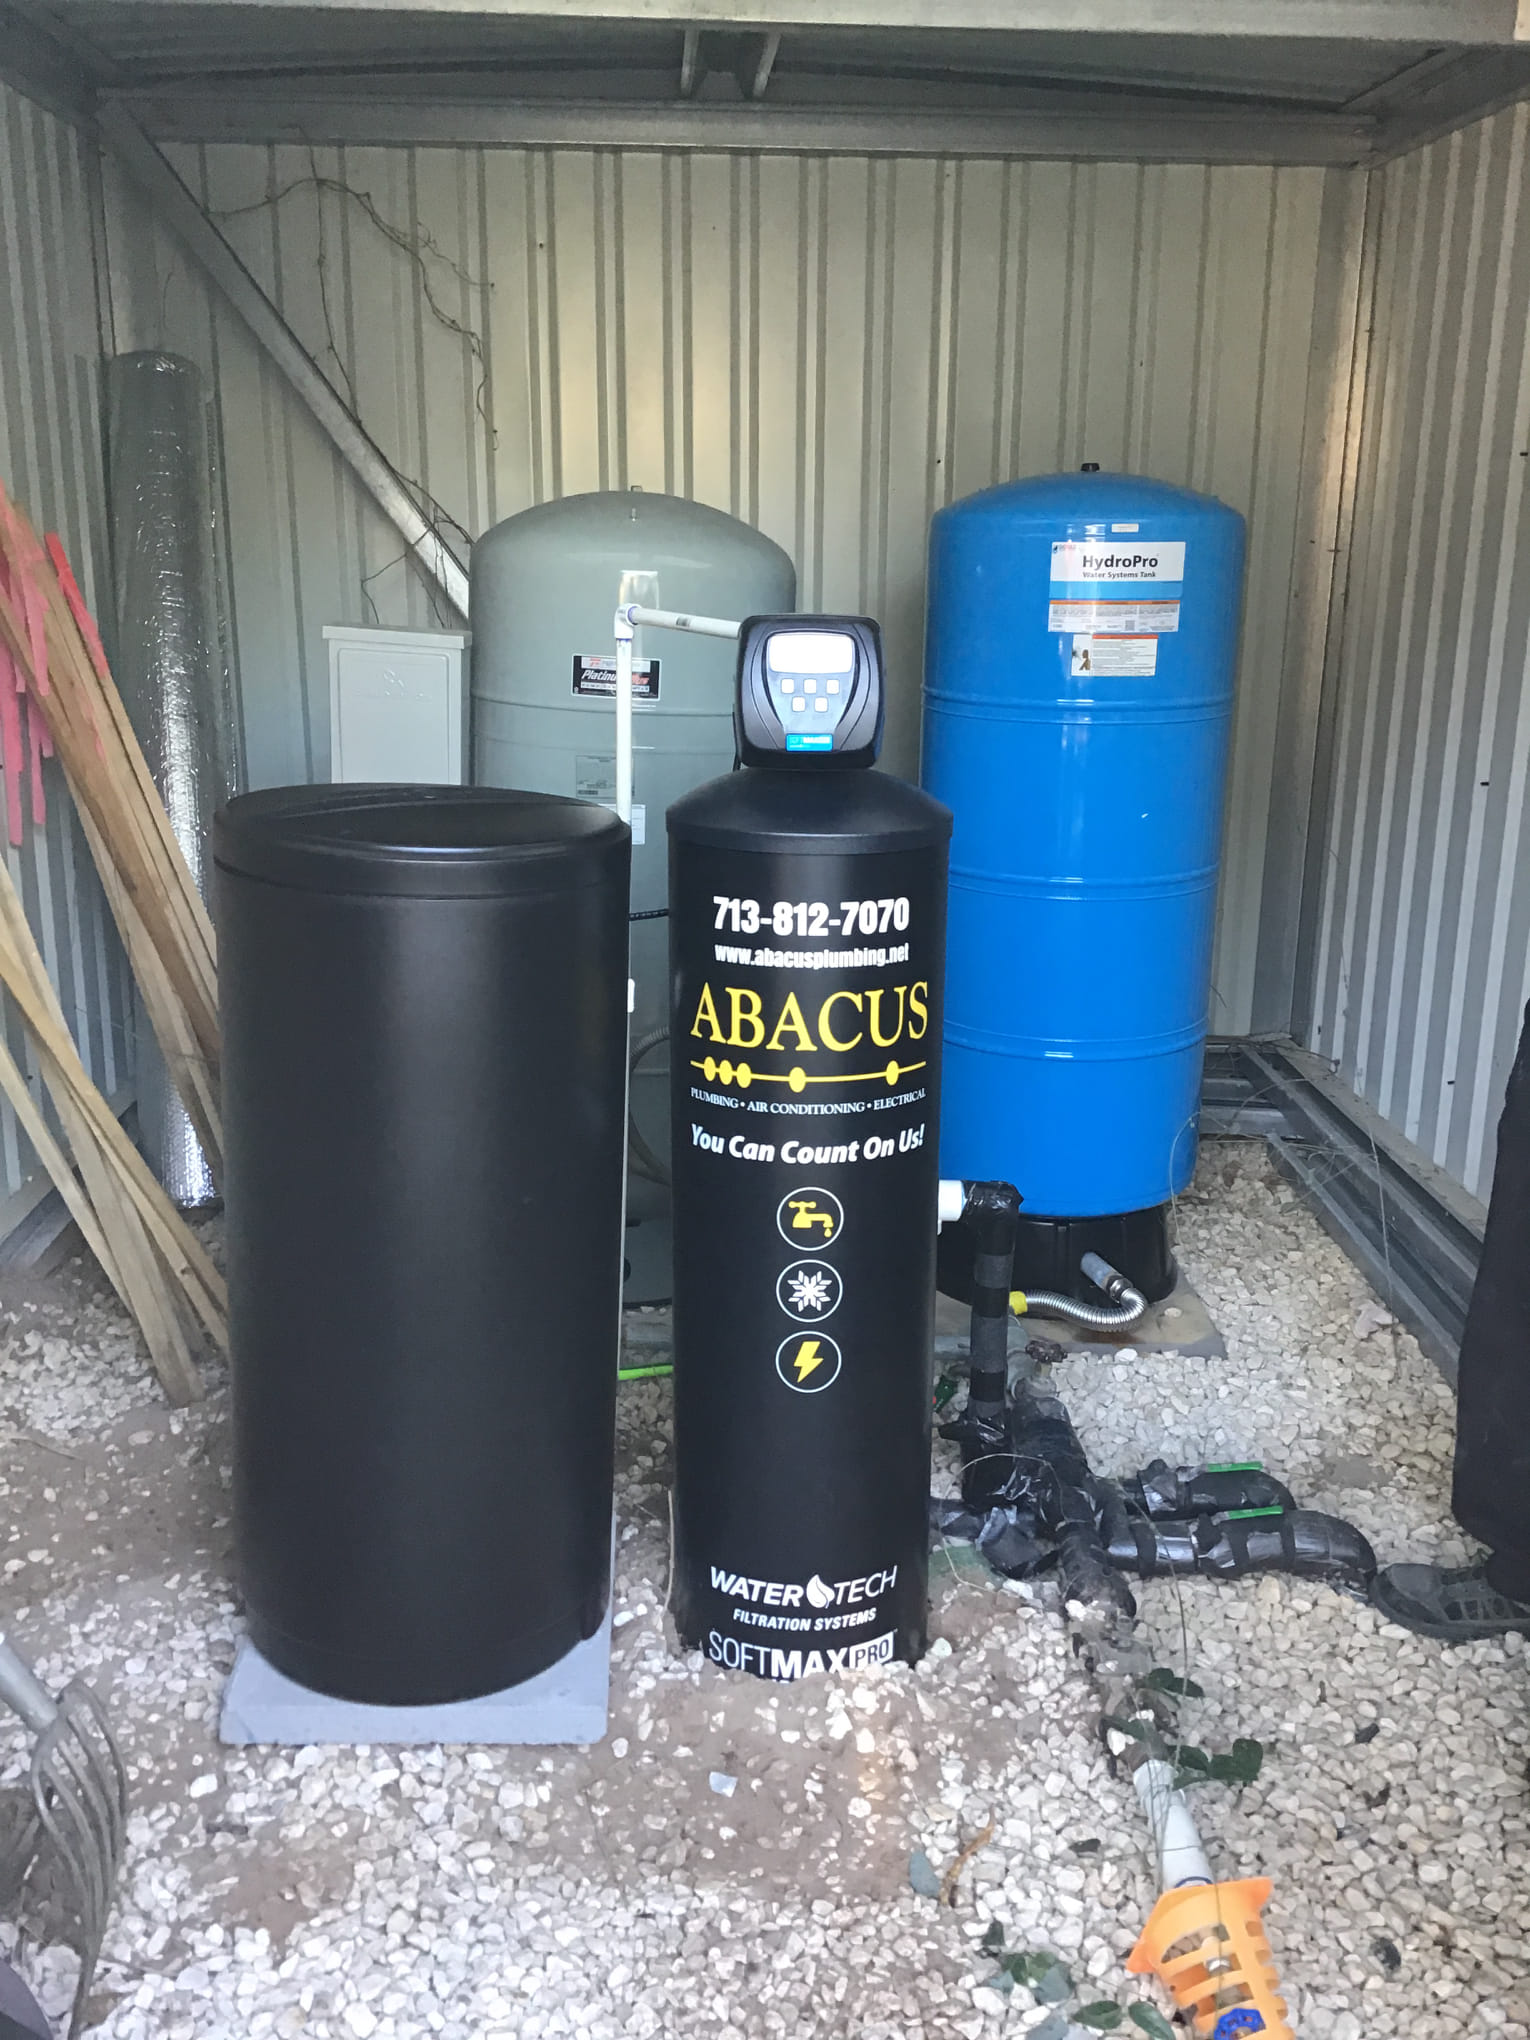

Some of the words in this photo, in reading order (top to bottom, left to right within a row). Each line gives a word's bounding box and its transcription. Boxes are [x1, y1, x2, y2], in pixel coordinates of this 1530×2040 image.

[1082, 554, 1158, 571] HydroPro
[1107, 571, 1138, 580] Systems
[581, 669, 617, 681] Platinu
[713, 896, 910, 936] 713-812-7070
[714, 942, 909, 970] www.abacusplumbing.net
[690, 981, 928, 1052] ABACUS
[690, 1086, 739, 1109] PLUMBING
[747, 1101, 768, 1113] AIR
[770, 1101, 865, 1115] CONDITIONING
[873, 1087, 926, 1111] ELECTRICAL
[691, 1123, 725, 1153] You
[728, 1135, 774, 1162] Can
[780, 1140, 859, 1165] Count
[863, 1136, 895, 1160] On
[898, 1123, 925, 1153] Us!
[710, 1565, 804, 1608] WATER
[833, 1565, 898, 1605] TECH
[733, 1608, 811, 1632] FILTRATION
[814, 1607, 877, 1632] SYSTEMS
